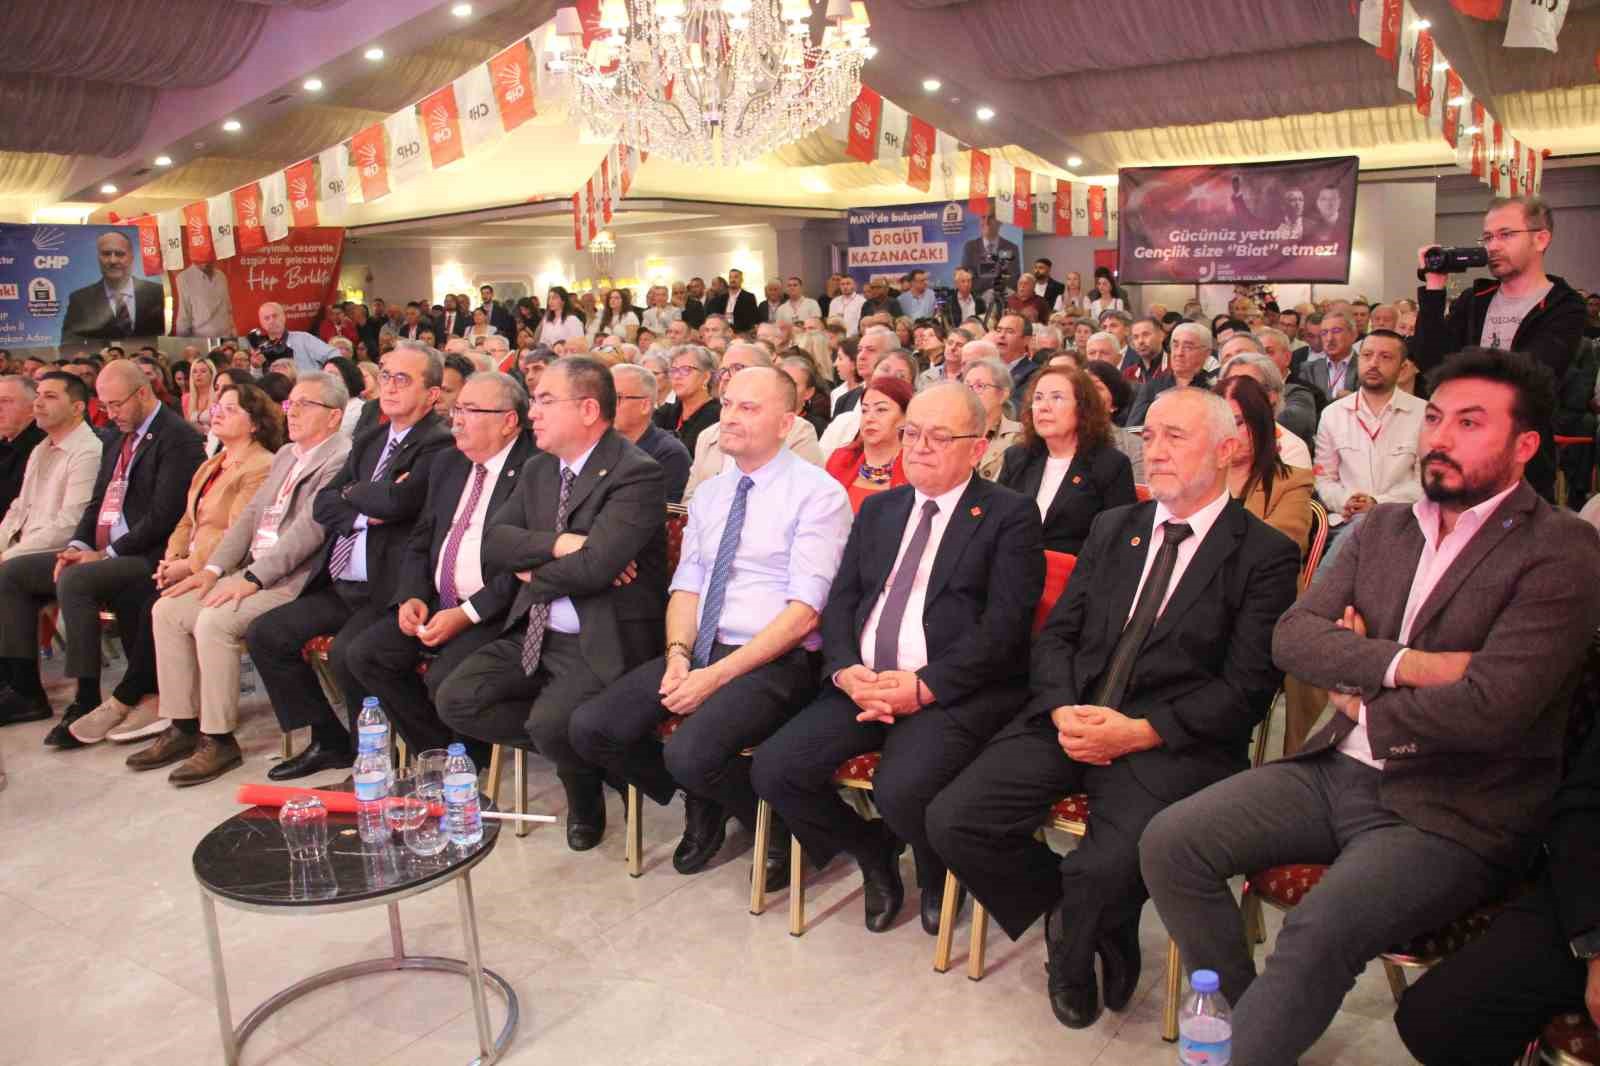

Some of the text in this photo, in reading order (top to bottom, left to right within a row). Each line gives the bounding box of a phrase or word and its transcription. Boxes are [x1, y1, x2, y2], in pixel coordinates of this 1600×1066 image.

[872, 228, 920, 246] ÖRGÜT
[1168, 228, 1299, 244] Gücünüz yetmez
[851, 247, 944, 265] KAZANACAK!
[1134, 245, 1191, 261] Gençlik
[1193, 244, 1224, 257] size
[1282, 242, 1339, 257] etmez!
[34, 255, 70, 269] CHP
